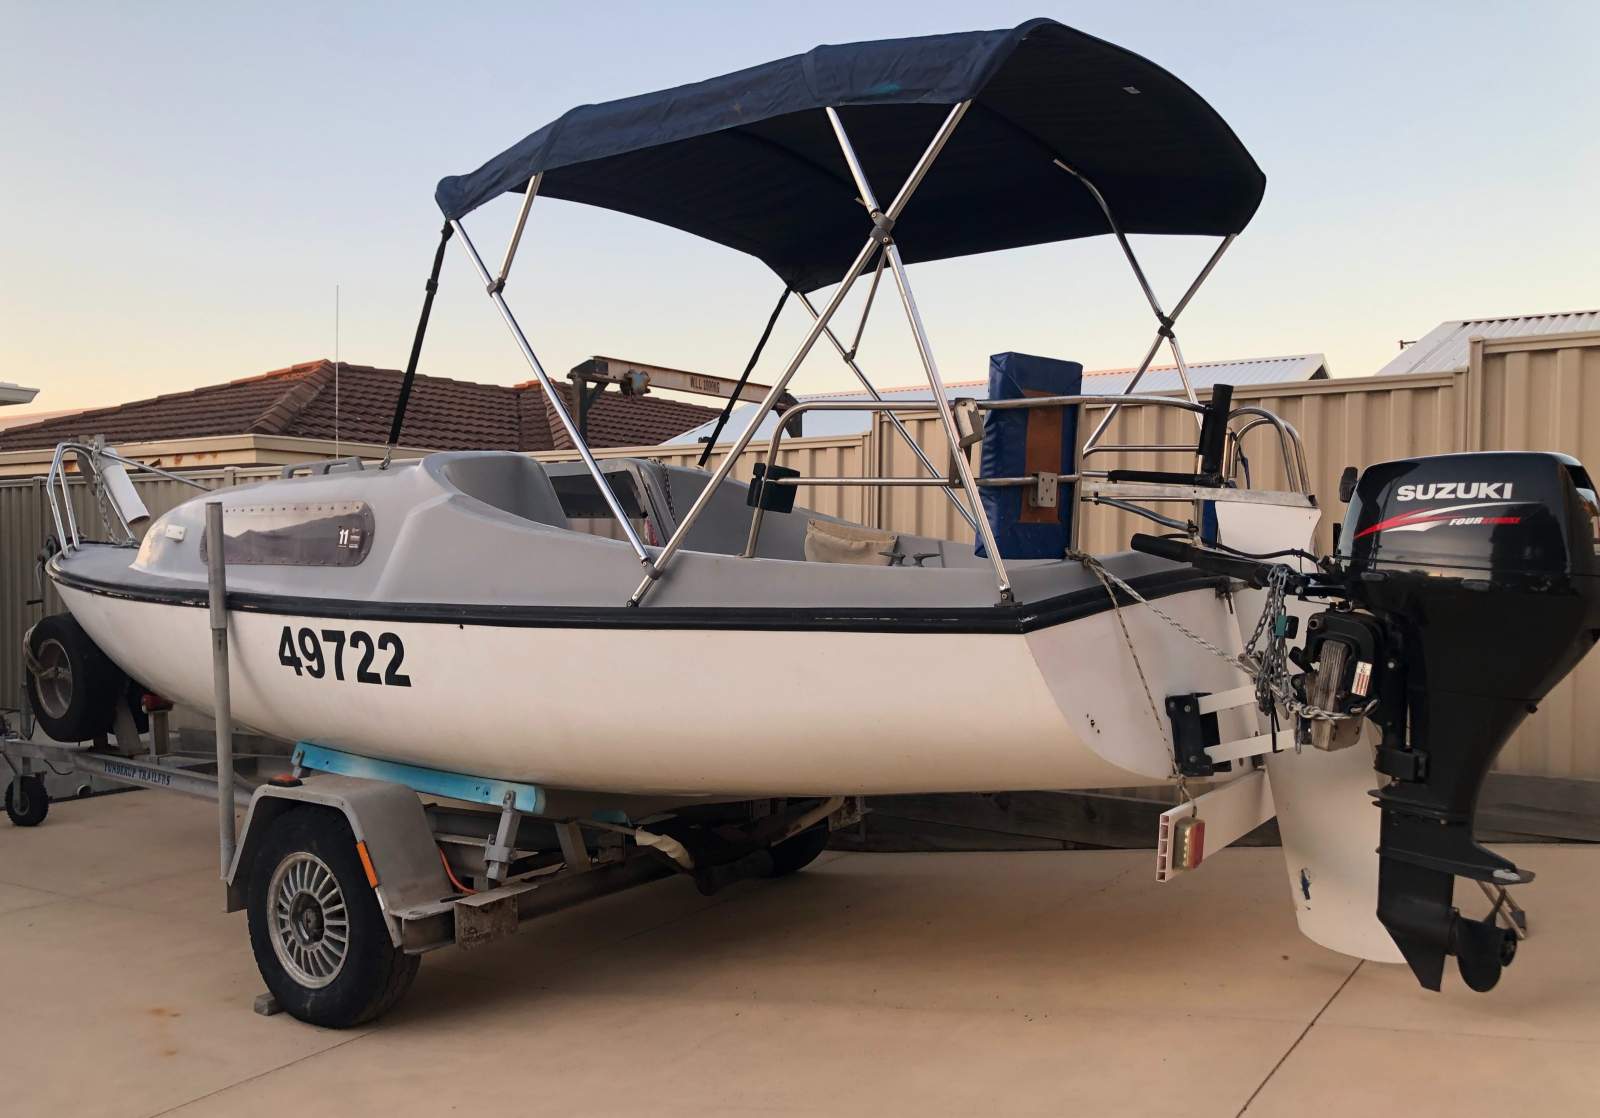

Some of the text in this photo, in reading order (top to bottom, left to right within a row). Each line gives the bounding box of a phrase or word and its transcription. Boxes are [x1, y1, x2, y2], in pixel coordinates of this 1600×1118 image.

[1396, 482, 1513, 501] SUZUKI
[339, 529, 349, 545] 11
[279, 626, 411, 687] 49722
[138, 767, 171, 785] TRAILERS
